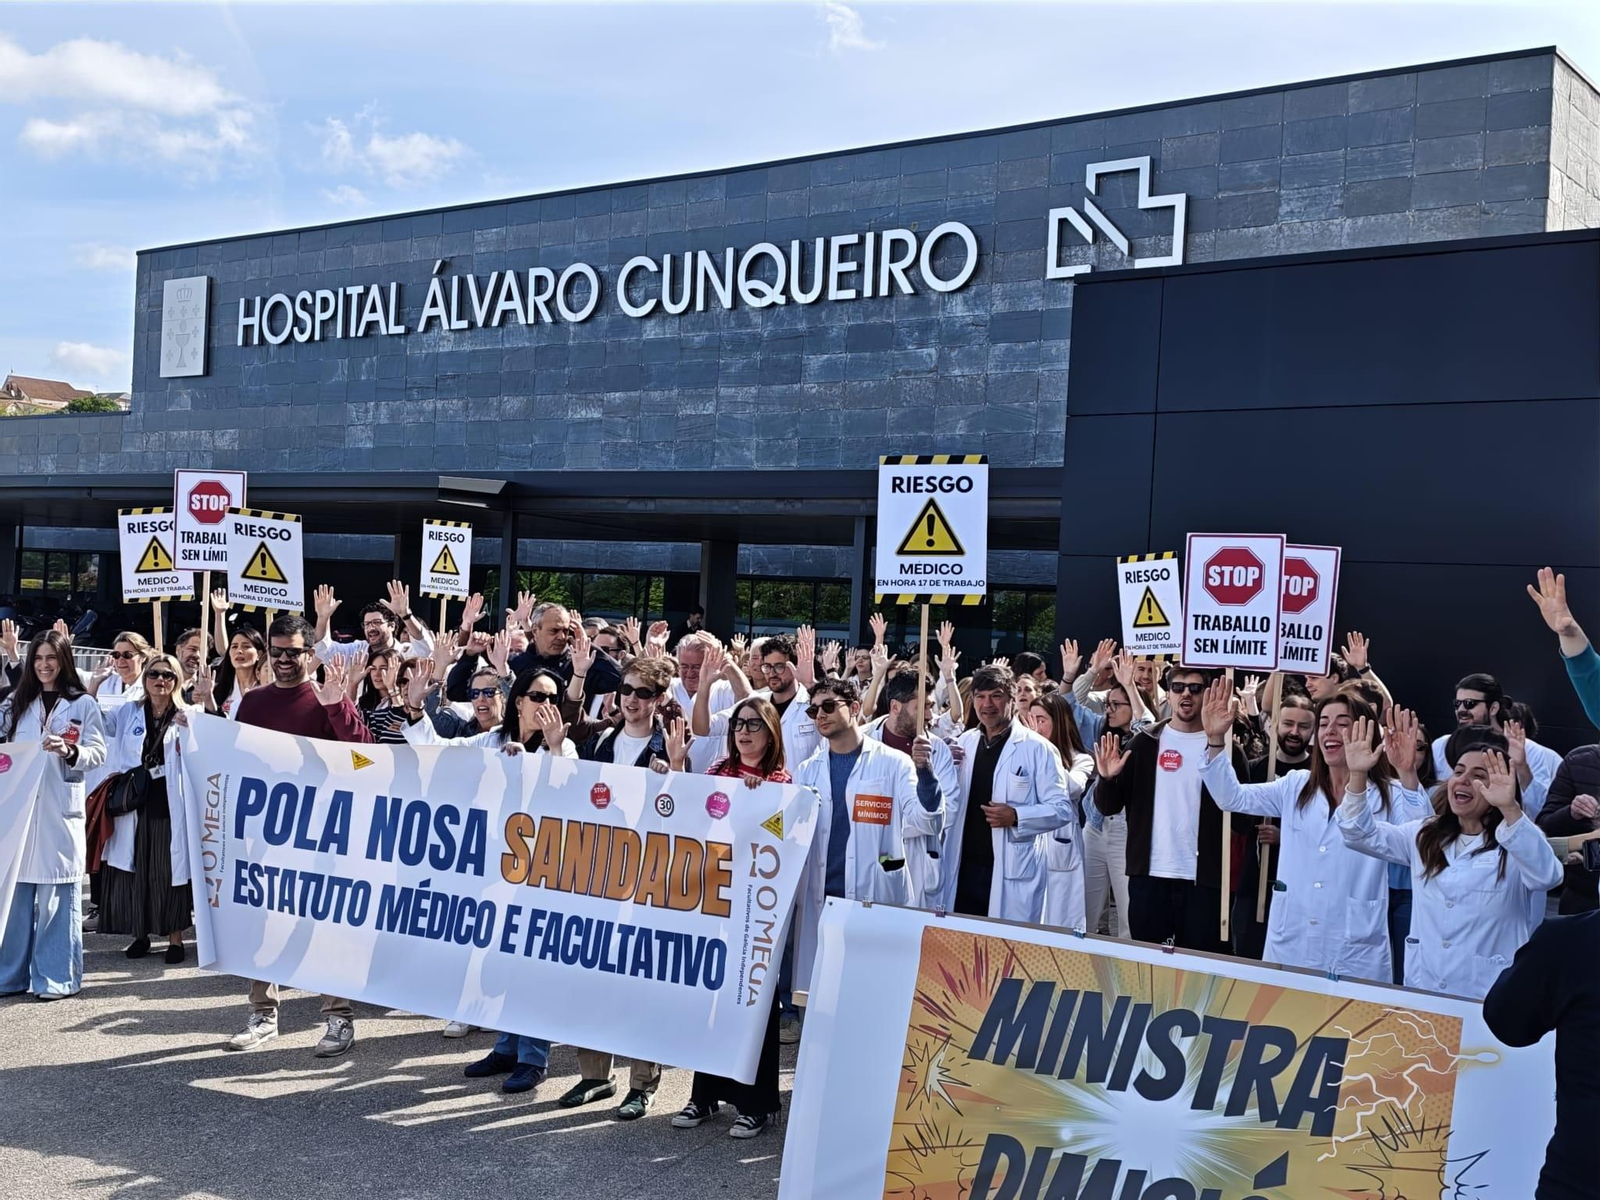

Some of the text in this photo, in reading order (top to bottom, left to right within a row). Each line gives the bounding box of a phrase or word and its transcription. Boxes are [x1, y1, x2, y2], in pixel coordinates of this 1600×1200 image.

[237, 221, 979, 346] HOSPITAL ÁLVARO CUNQUEIRO
[892, 476, 974, 494] RIESGO
[191, 494, 229, 511] STOP
[180, 531, 227, 545] TRABALL
[233, 522, 292, 542] RIESGO
[428, 530, 466, 544] RIESGO
[181, 549, 200, 561] SEN
[137, 576, 180, 586] MEDICO
[431, 577, 460, 586] MEDICO
[877, 579, 986, 588] EN HORA 17 DE TRABAJO
[1125, 568, 1170, 584] RIESGO
[1208, 565, 1260, 588] STOP
[244, 584, 288, 597] MEDICO
[1283, 575, 1316, 597] TOP
[239, 593, 257, 601] HORA
[273, 598, 303, 607] TRABAJO
[1192, 614, 1271, 633] TRABALLO
[1135, 632, 1171, 642] MEDICO
[1280, 622, 1323, 641] BALLO
[1194, 634, 1269, 656] SEN LÍMITE
[593, 786, 607, 794] STOP
[659, 799, 672, 811] 30
[713, 795, 728, 803] STOP
[855, 800, 892, 809] SERVICIOS
[857, 809, 889, 820] MÍNIMOS
[235, 776, 733, 918] POLA NOSA SANIDADE
[233, 859, 728, 991] ESTATUTO MÉDICO E FACULTATIVO
[737, 884, 753, 1005] Facultativos de Galicia Independentes
[967, 976, 1349, 1138] MINISTRA
